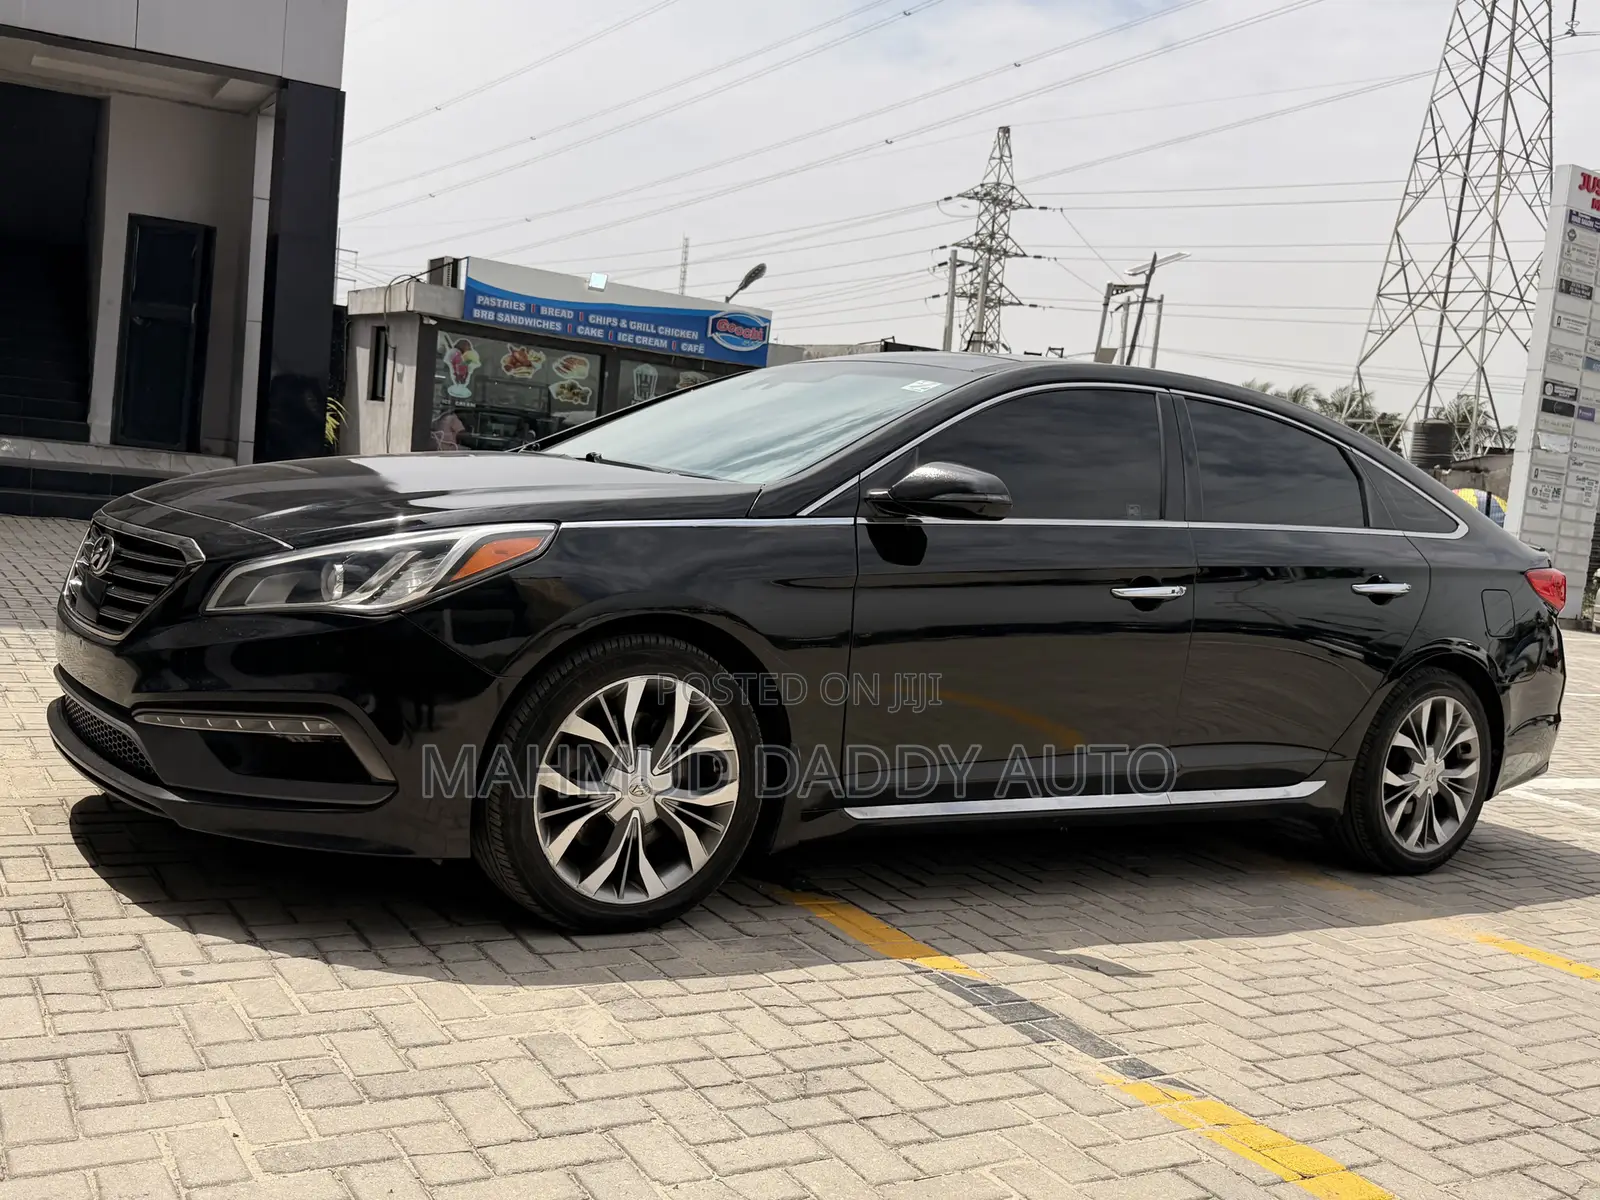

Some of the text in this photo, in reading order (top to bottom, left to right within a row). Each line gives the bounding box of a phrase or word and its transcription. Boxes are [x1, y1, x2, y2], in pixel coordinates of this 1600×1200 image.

[476, 295, 526, 311] PASTRIES
[473, 309, 562, 331] BRB SANDWICHES
[540, 306, 574, 319] BREAD
[577, 325, 604, 338] CAKE
[588, 314, 698, 340] CHIPS & GRILL CHICKEN
[617, 332, 668, 348] ICE CREAM
